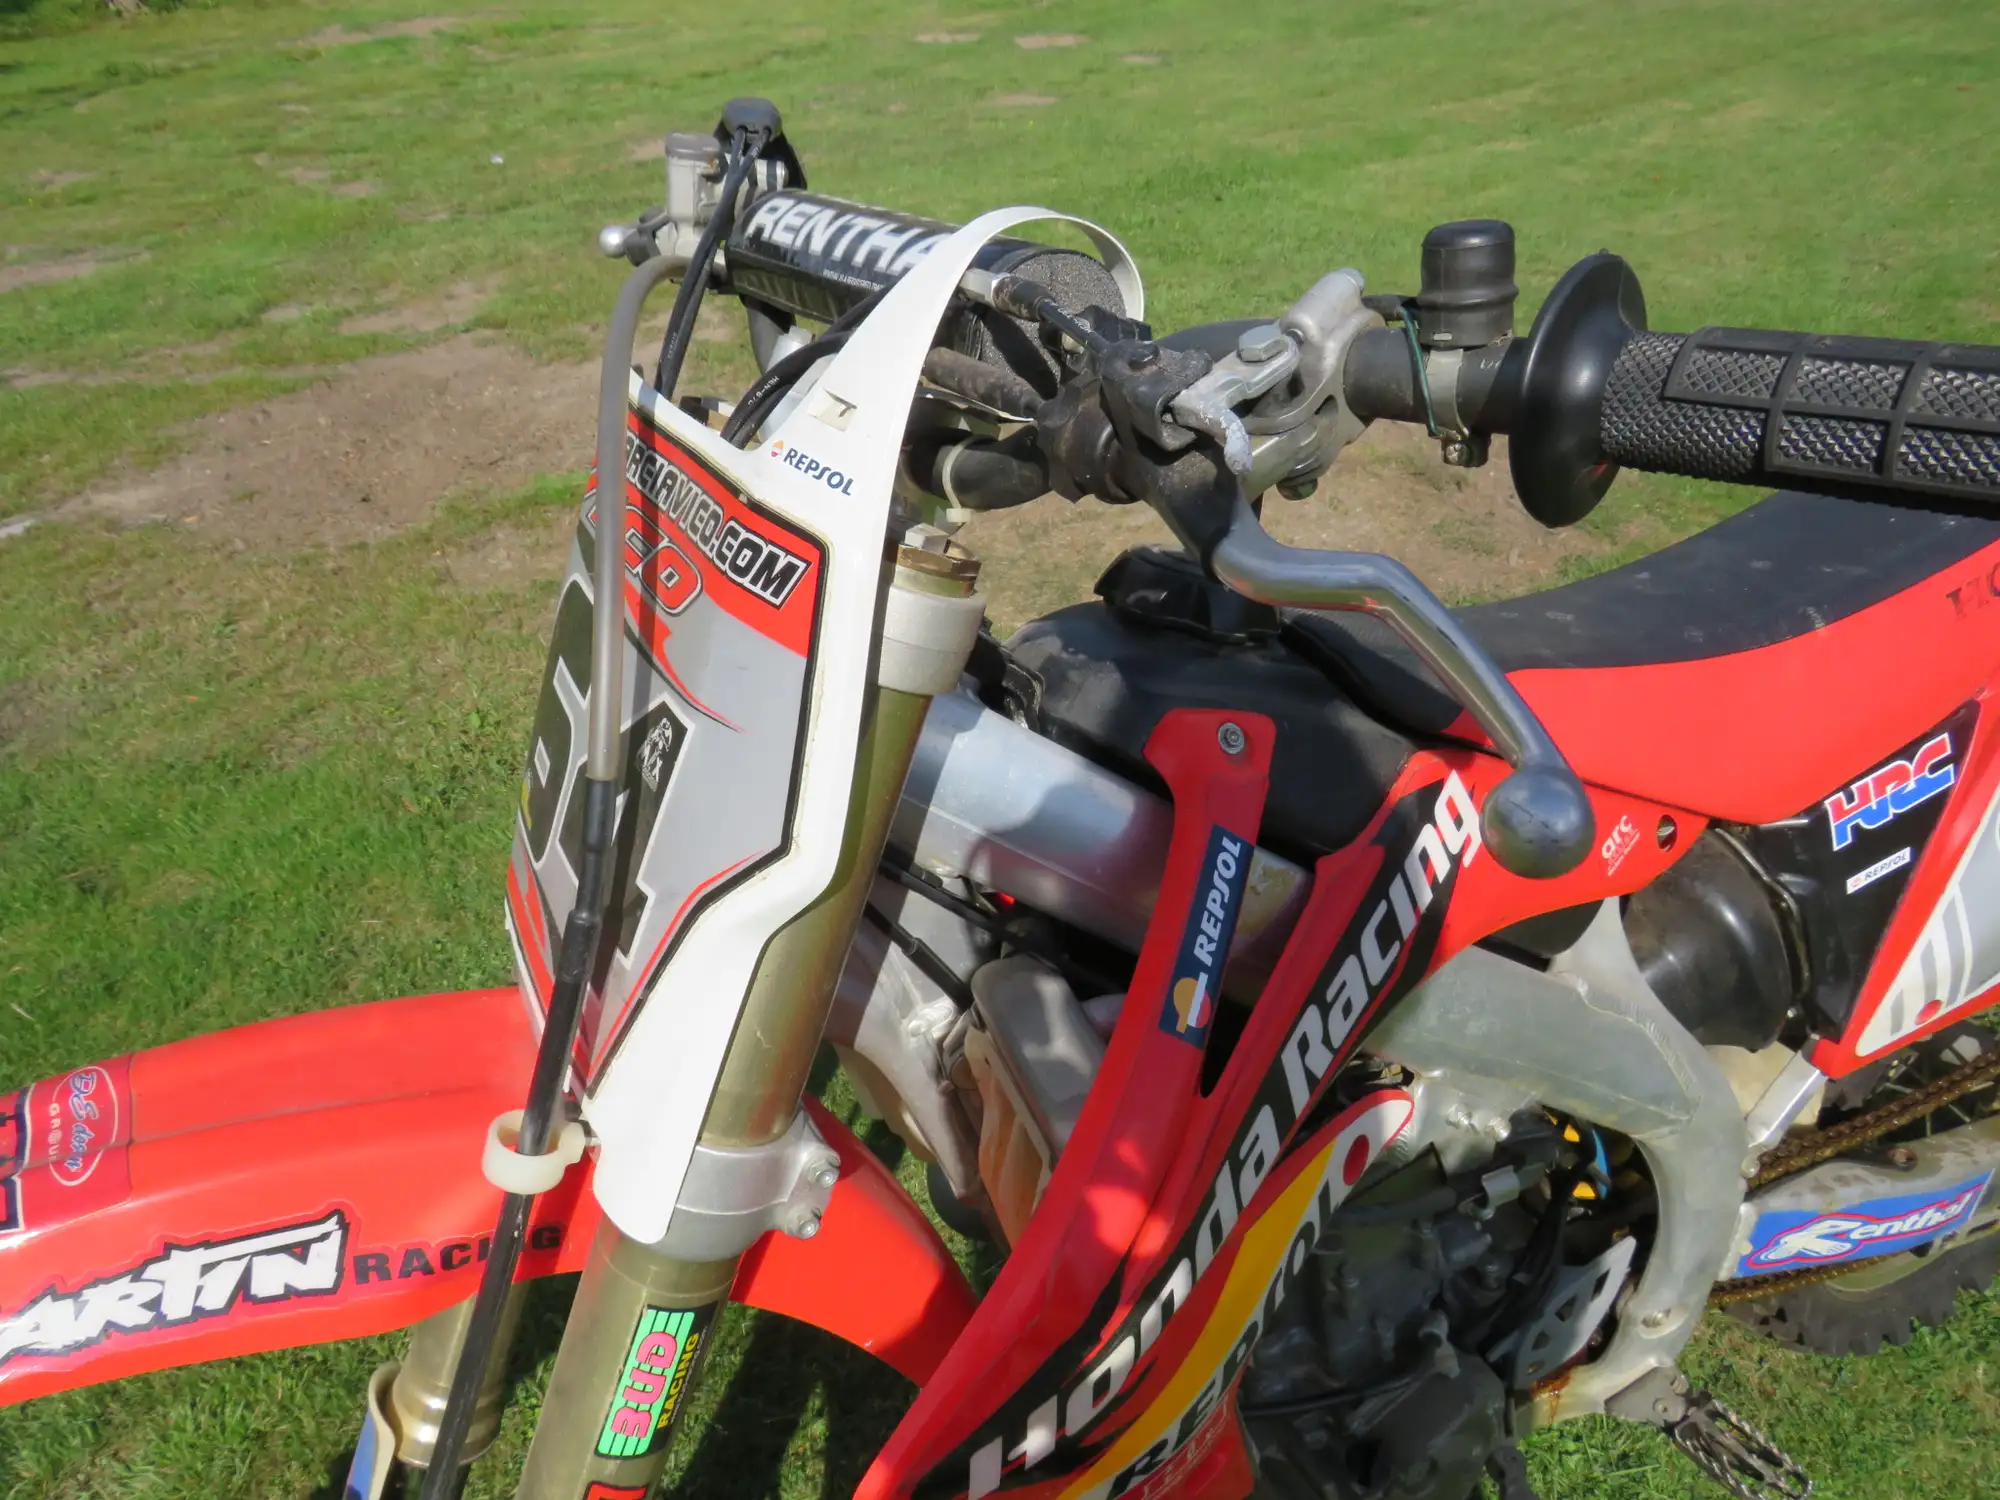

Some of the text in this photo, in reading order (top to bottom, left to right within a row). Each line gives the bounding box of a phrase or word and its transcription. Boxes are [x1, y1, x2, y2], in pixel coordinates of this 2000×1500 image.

[744, 196, 952, 277] RENTHA
[783, 446, 854, 496] REPSOL
[1824, 732, 1956, 851] HRC
[1193, 835, 1242, 967] REPSOL
[1864, 851, 1907, 881] REPSOL
[967, 769, 1482, 1500] Honda Racing
[1760, 1191, 1973, 1263] Renthal
[0, 1211, 562, 1368] ARTIN RACIG
[610, 1330, 678, 1439] BUD
[656, 1331, 700, 1430] RACING
